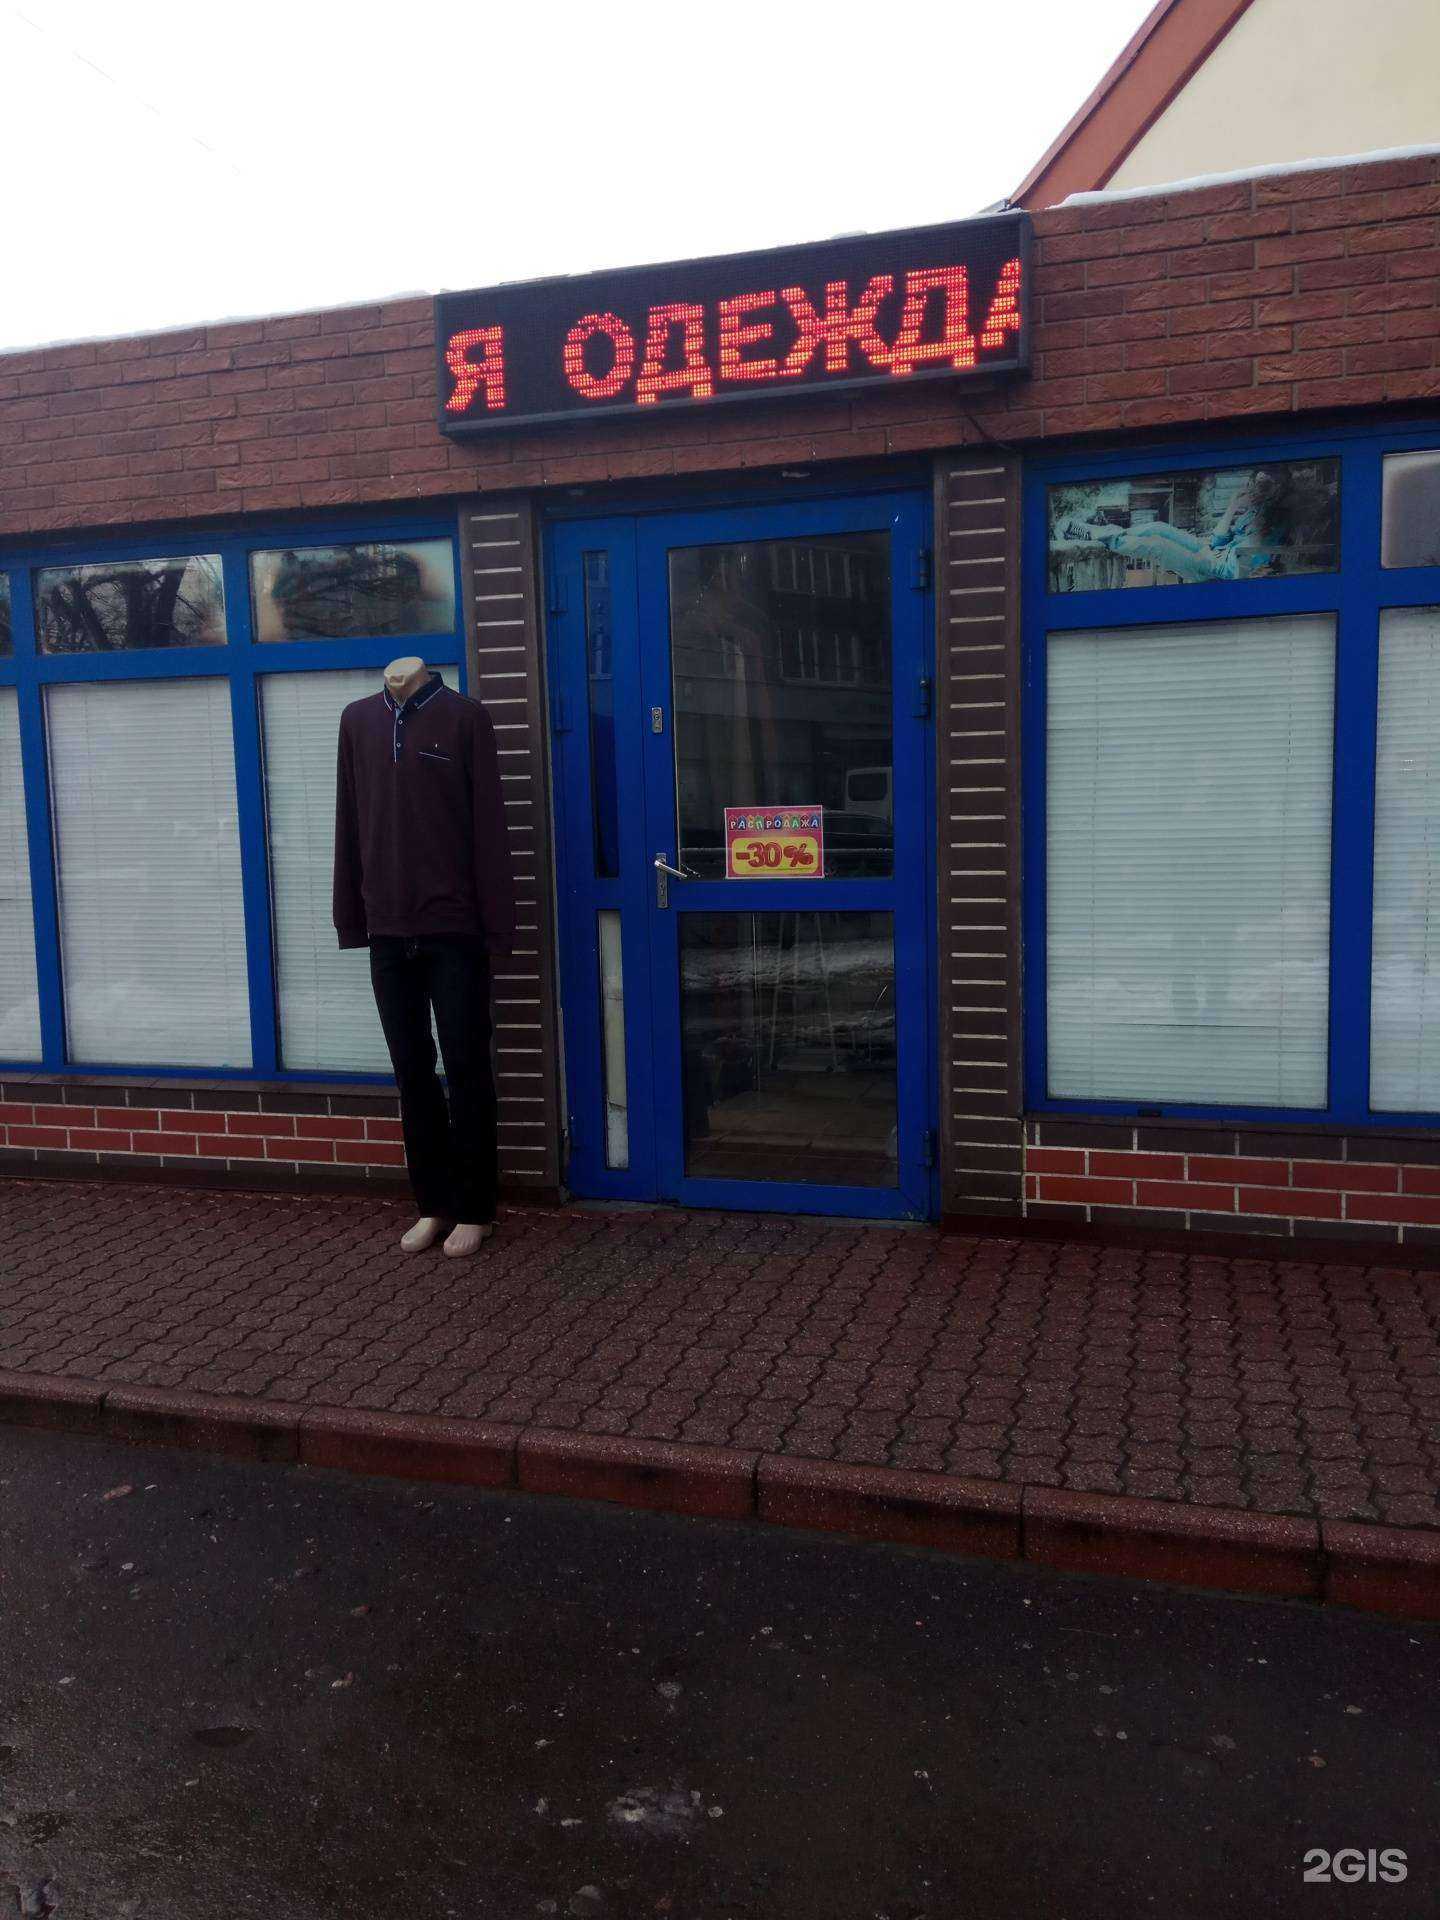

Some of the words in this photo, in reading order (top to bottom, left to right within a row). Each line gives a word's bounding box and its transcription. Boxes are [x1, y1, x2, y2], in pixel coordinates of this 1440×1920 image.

[445, 325, 504, 411] Я
[729, 816, 820, 829] РАСПРОДАЖА
[735, 842, 814, 868] -30%
